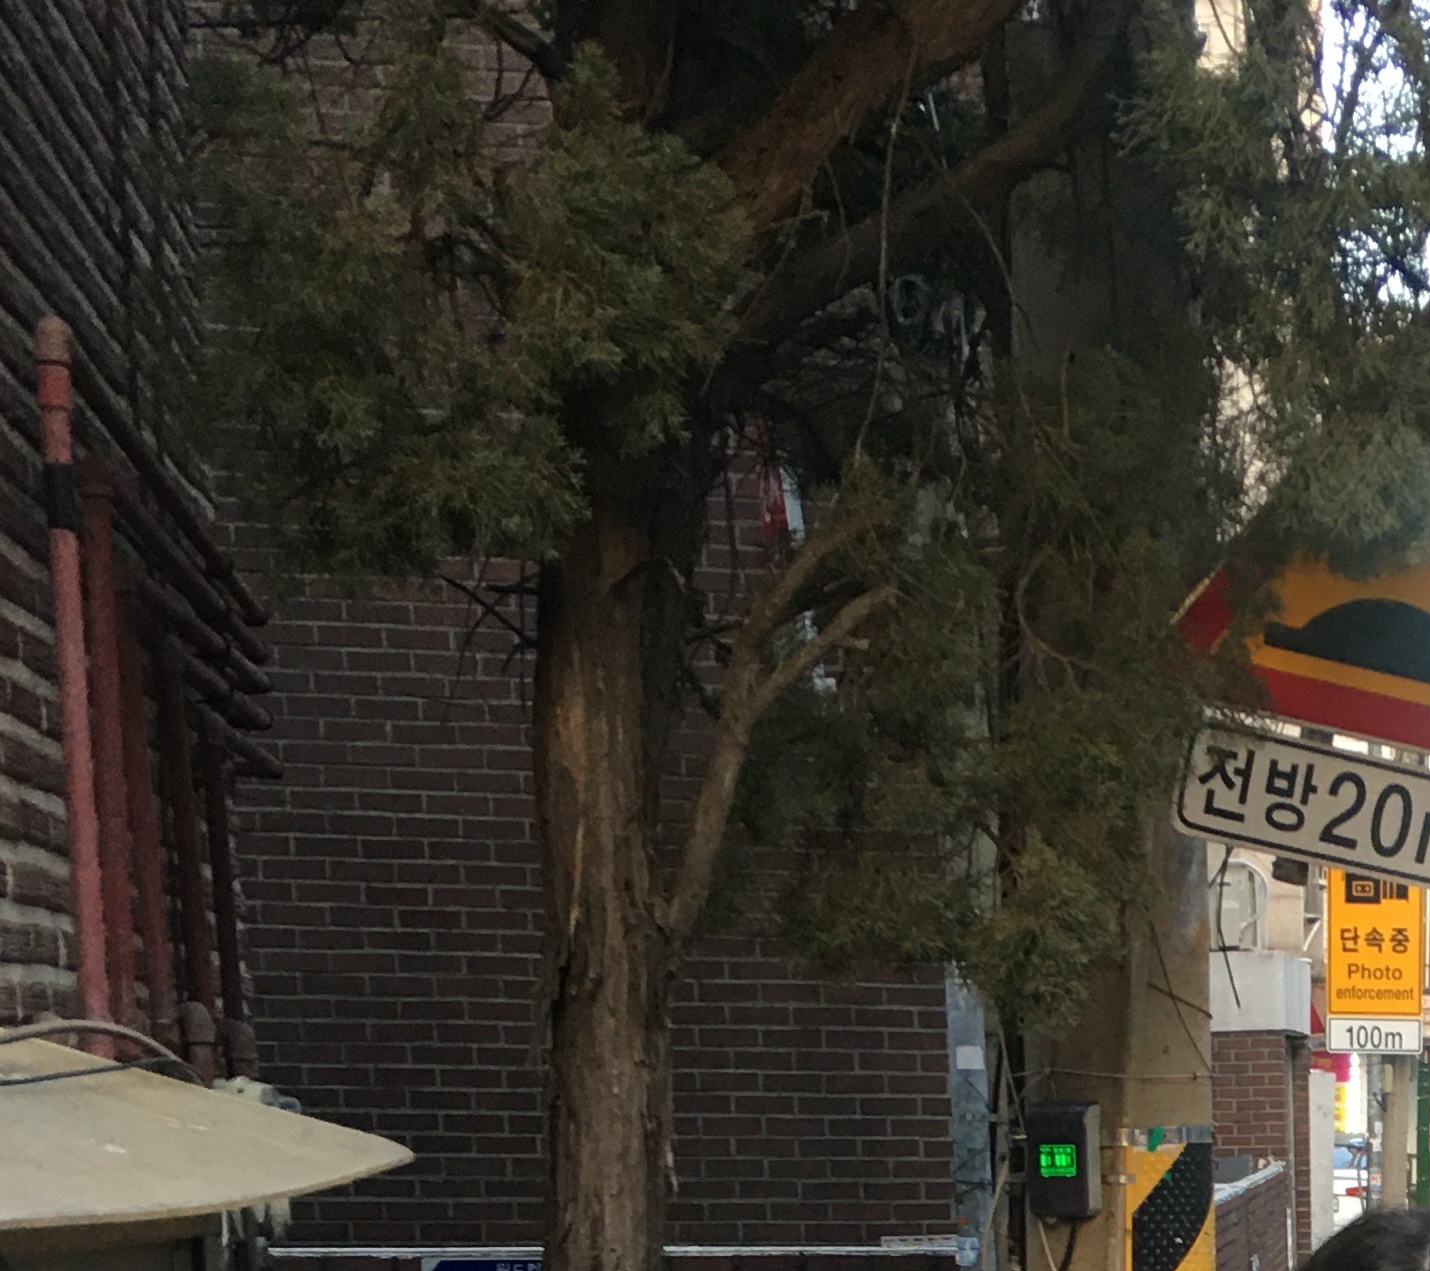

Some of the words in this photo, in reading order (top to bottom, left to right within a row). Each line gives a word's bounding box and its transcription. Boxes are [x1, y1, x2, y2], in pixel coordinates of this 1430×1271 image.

[1340, 926, 1410, 954] 단속중
[1347, 963, 1403, 980] Photo
[1336, 986, 1414, 1000] enforcement
[1346, 1025, 1403, 1049] 100m
